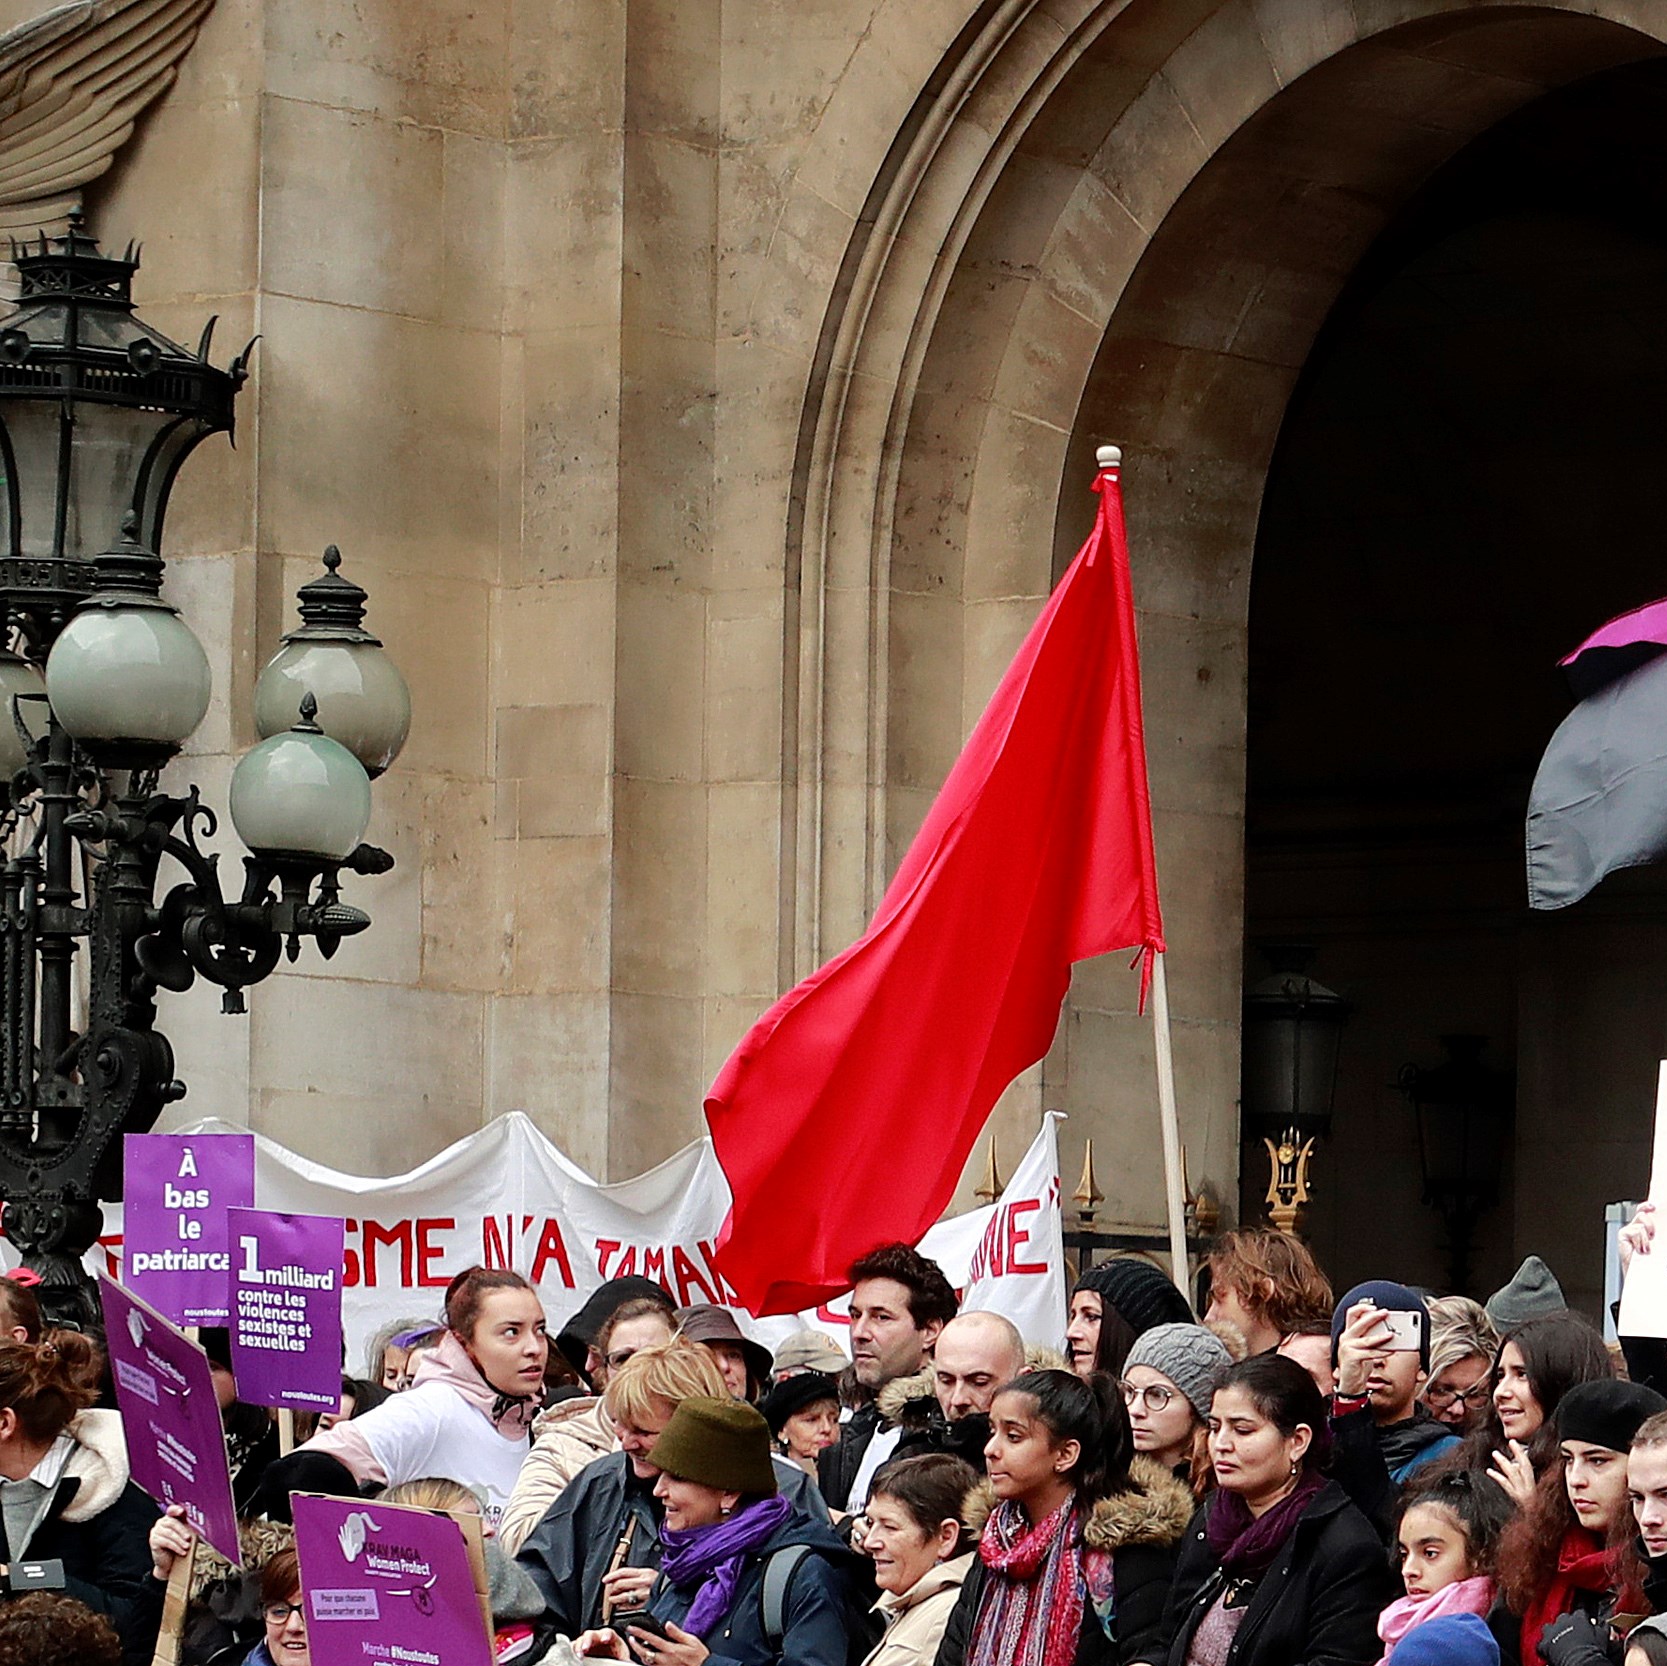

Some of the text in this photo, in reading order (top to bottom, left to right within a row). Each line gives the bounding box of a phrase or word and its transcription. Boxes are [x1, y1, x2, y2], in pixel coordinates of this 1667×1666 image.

[177, 1147, 199, 1177] À
[163, 1182, 210, 1210] bas
[177, 1213, 202, 1240] le
[237, 1234, 335, 1291] 1 milliard
[237, 1289, 308, 1308] contre les
[237, 1304, 306, 1323] violences
[237, 1318, 313, 1339] sexistes et
[237, 1333, 307, 1353] sexuelles
